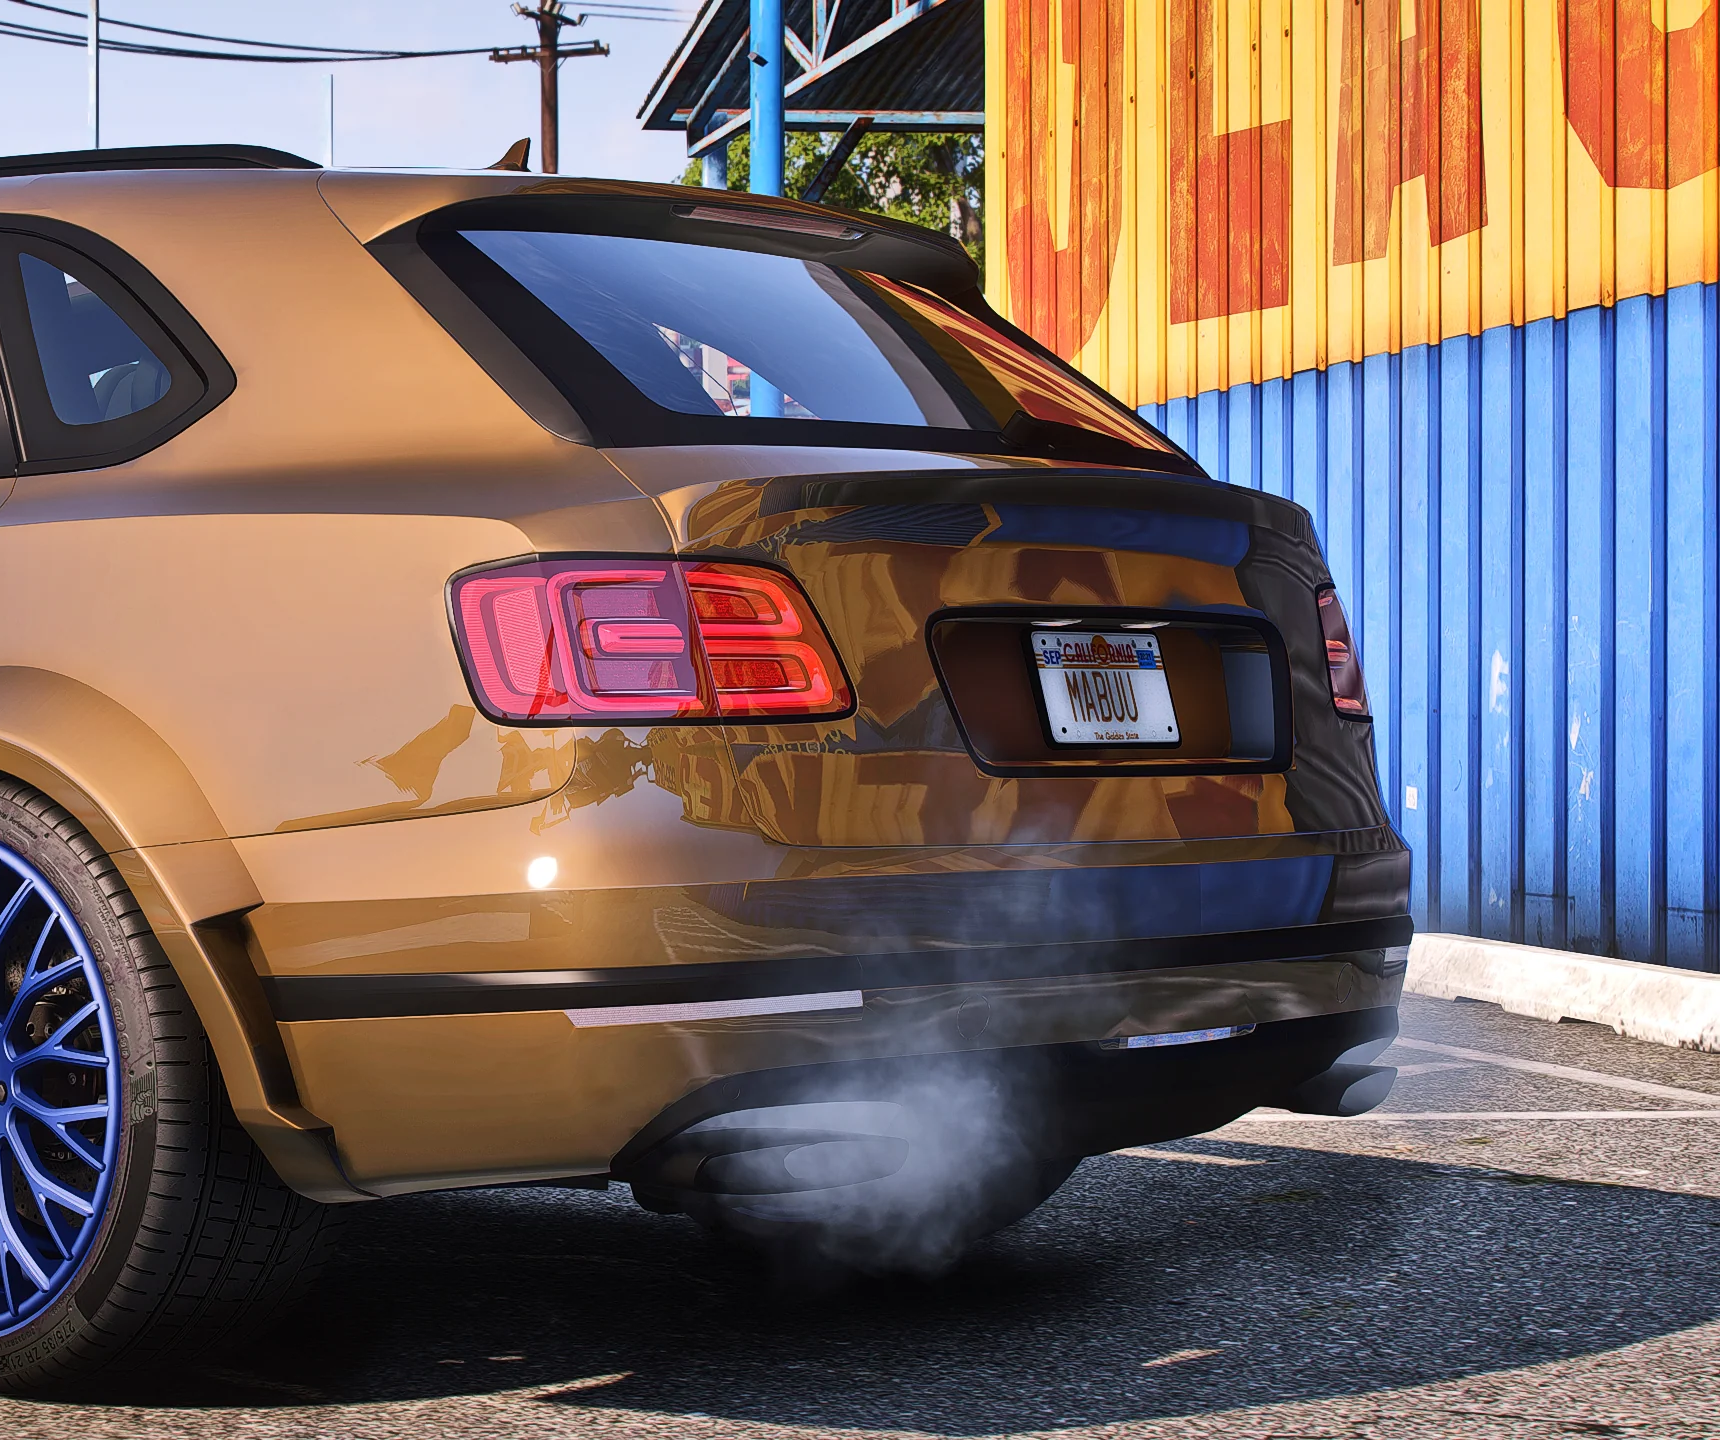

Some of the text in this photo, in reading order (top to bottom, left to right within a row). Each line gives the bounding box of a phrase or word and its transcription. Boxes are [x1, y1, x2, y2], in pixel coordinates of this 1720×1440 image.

[1043, 650, 1061, 665] SEP
[1063, 643, 1134, 663] CALIFORNIA
[1064, 671, 1138, 723] MABUU
[1094, 731, 1104, 740] The
[1105, 731, 1125, 740] Golden
[11, 1320, 76, 1370] 275/35 ZR 21
